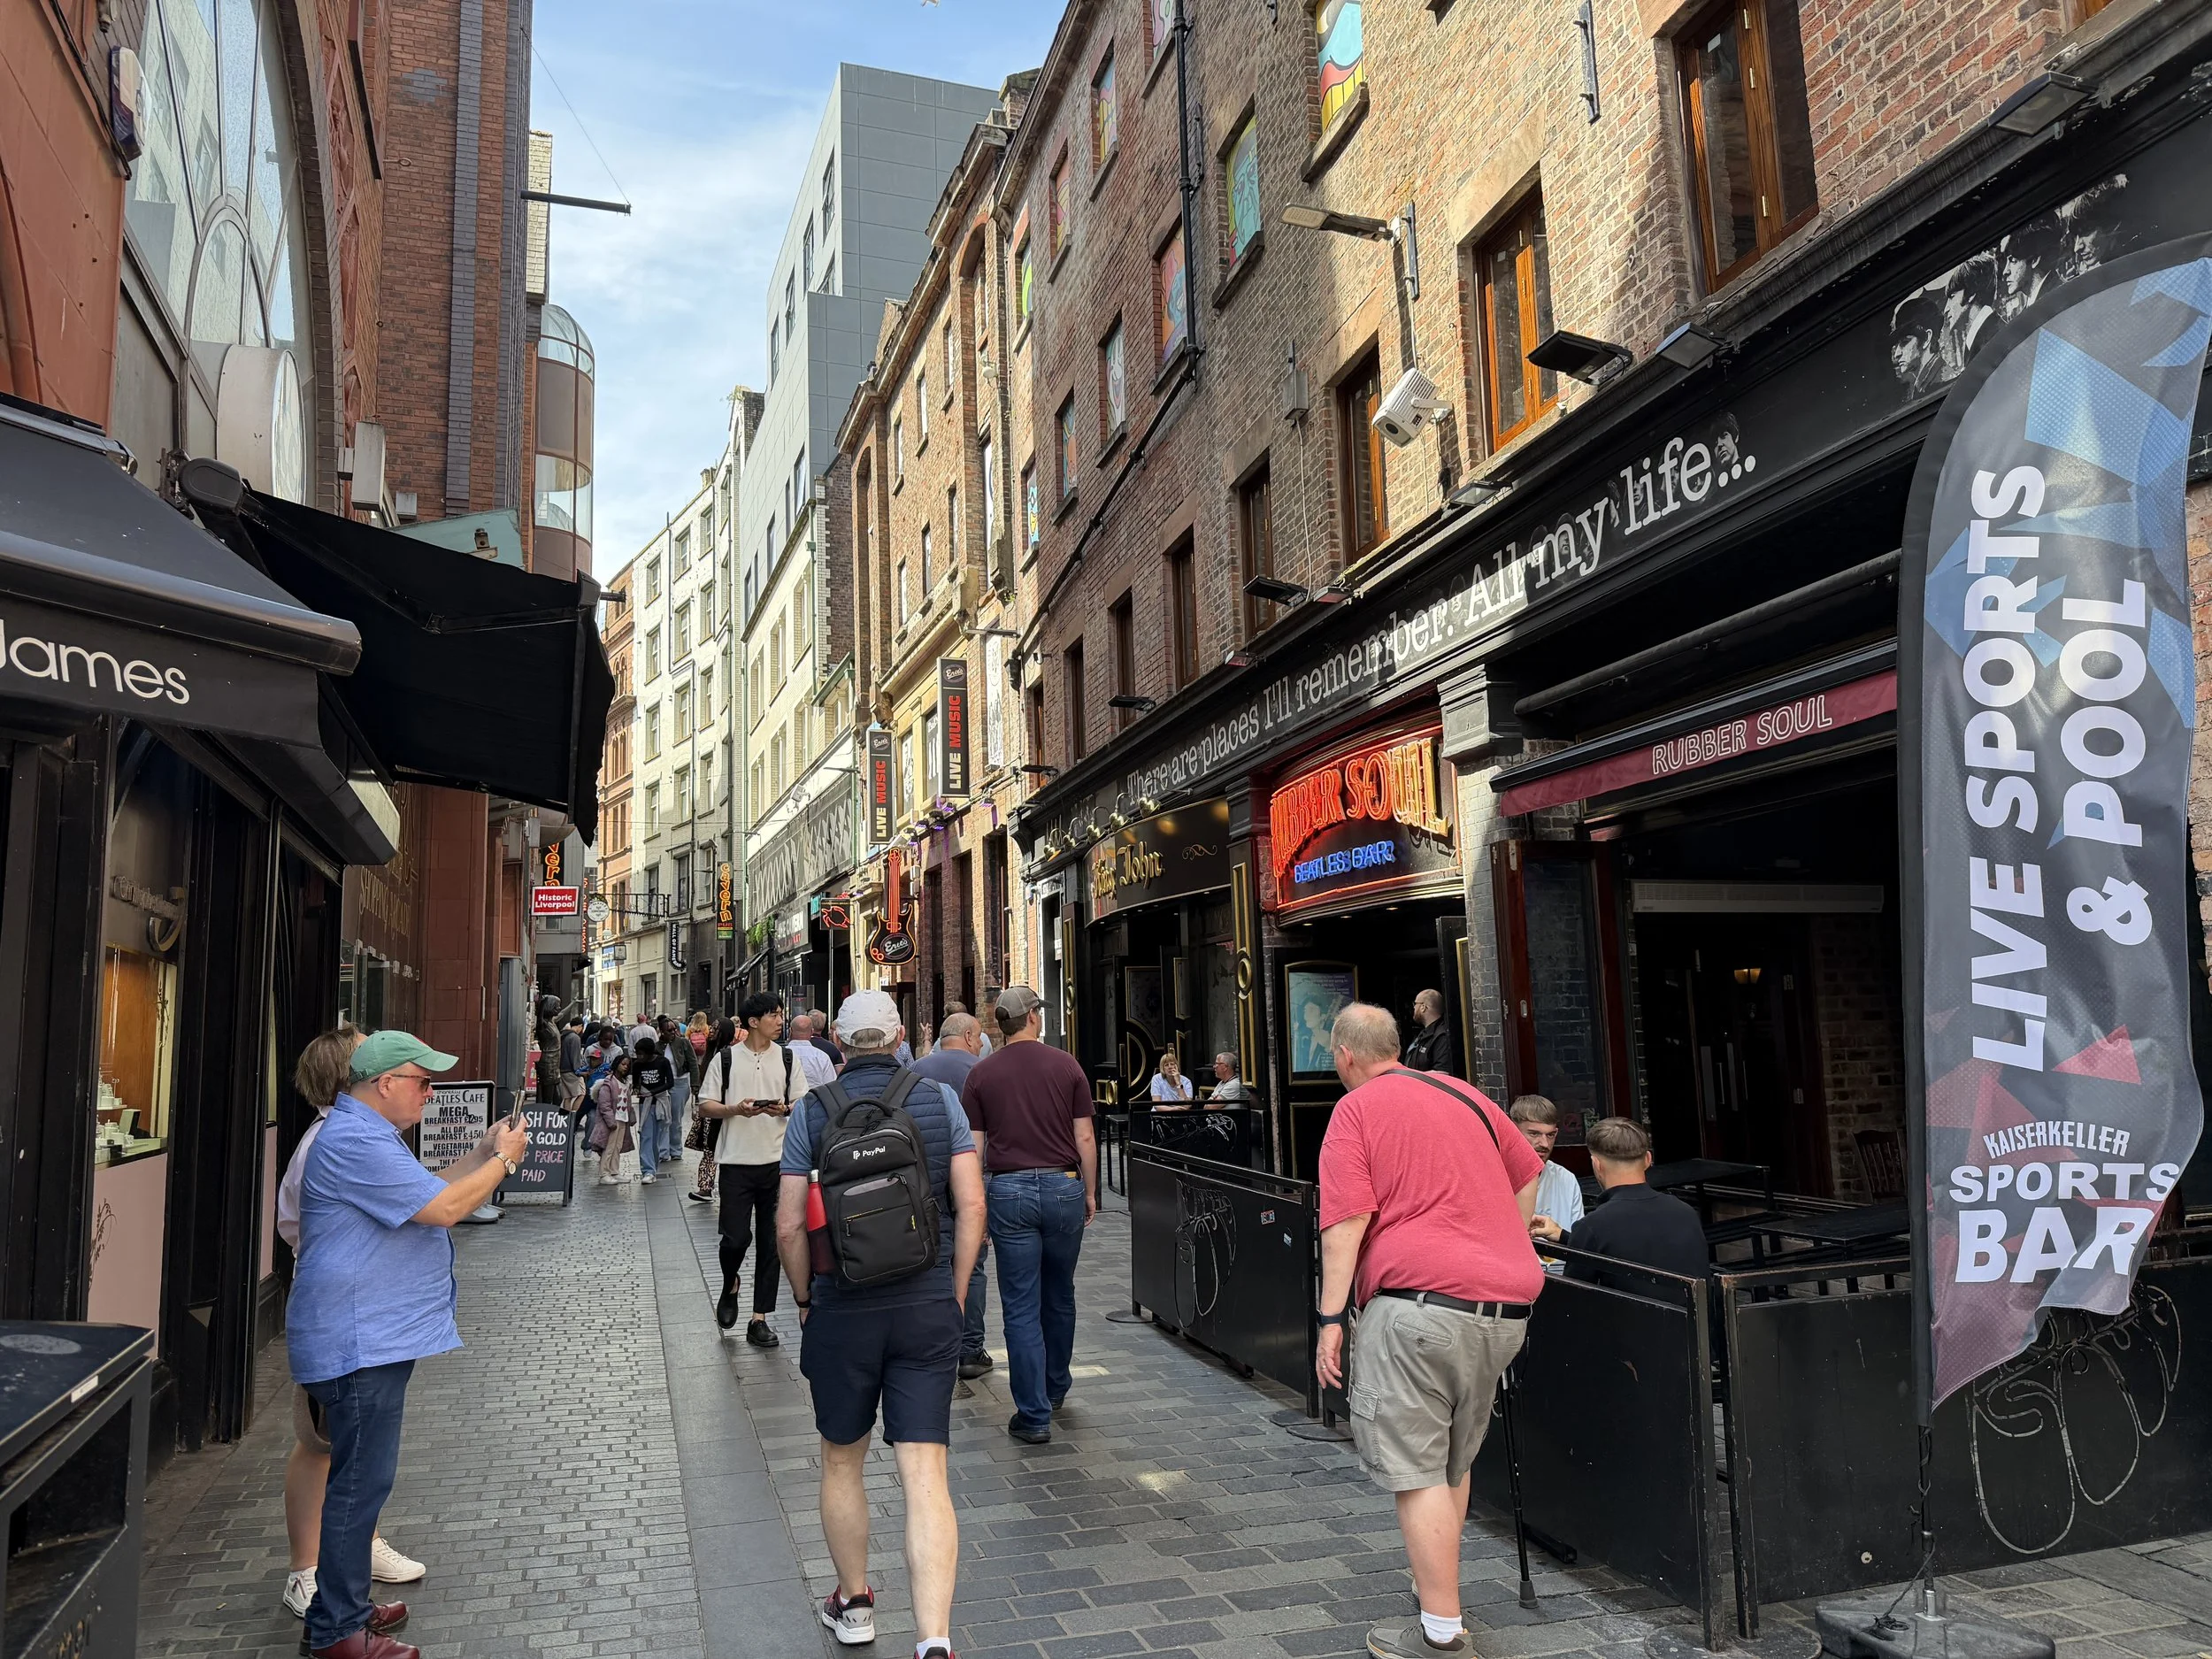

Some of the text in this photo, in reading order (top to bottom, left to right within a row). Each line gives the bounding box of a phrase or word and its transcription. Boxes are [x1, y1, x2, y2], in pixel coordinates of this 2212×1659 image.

[1127, 763, 1168, 806] There
[1171, 745, 1198, 786] are
[1201, 703, 1259, 777] places
[1263, 676, 1292, 730] I'll
[1296, 596, 1454, 712] remember.
[1464, 541, 1525, 627] All
[1534, 497, 1609, 589] my
[949, 695, 962, 789] LIVE MUSIC
[1652, 694, 1832, 775] RUBBER SOUL
[1962, 465, 2047, 1072] LIVE SPORTS
[2059, 579, 2153, 946] & POOL
[875, 760, 887, 838] LIVE MUSIC
[1345, 737, 1448, 837] SOUL
[1352, 840, 1396, 871] BAR
[534, 900, 575, 909] Liverpool
[439, 1106, 469, 1117] MEGA
[545, 1111, 567, 1128] FOR
[534, 1150, 565, 1164] PRICE
[536, 1131, 566, 1146] GOLD
[863, 1146, 886, 1157] PayPal
[1983, 1120, 2131, 1159] KAISERKELLER
[521, 1169, 546, 1183] PAID
[1948, 1162, 2180, 1202] SPORTS
[1955, 1206, 2155, 1283] BAR
